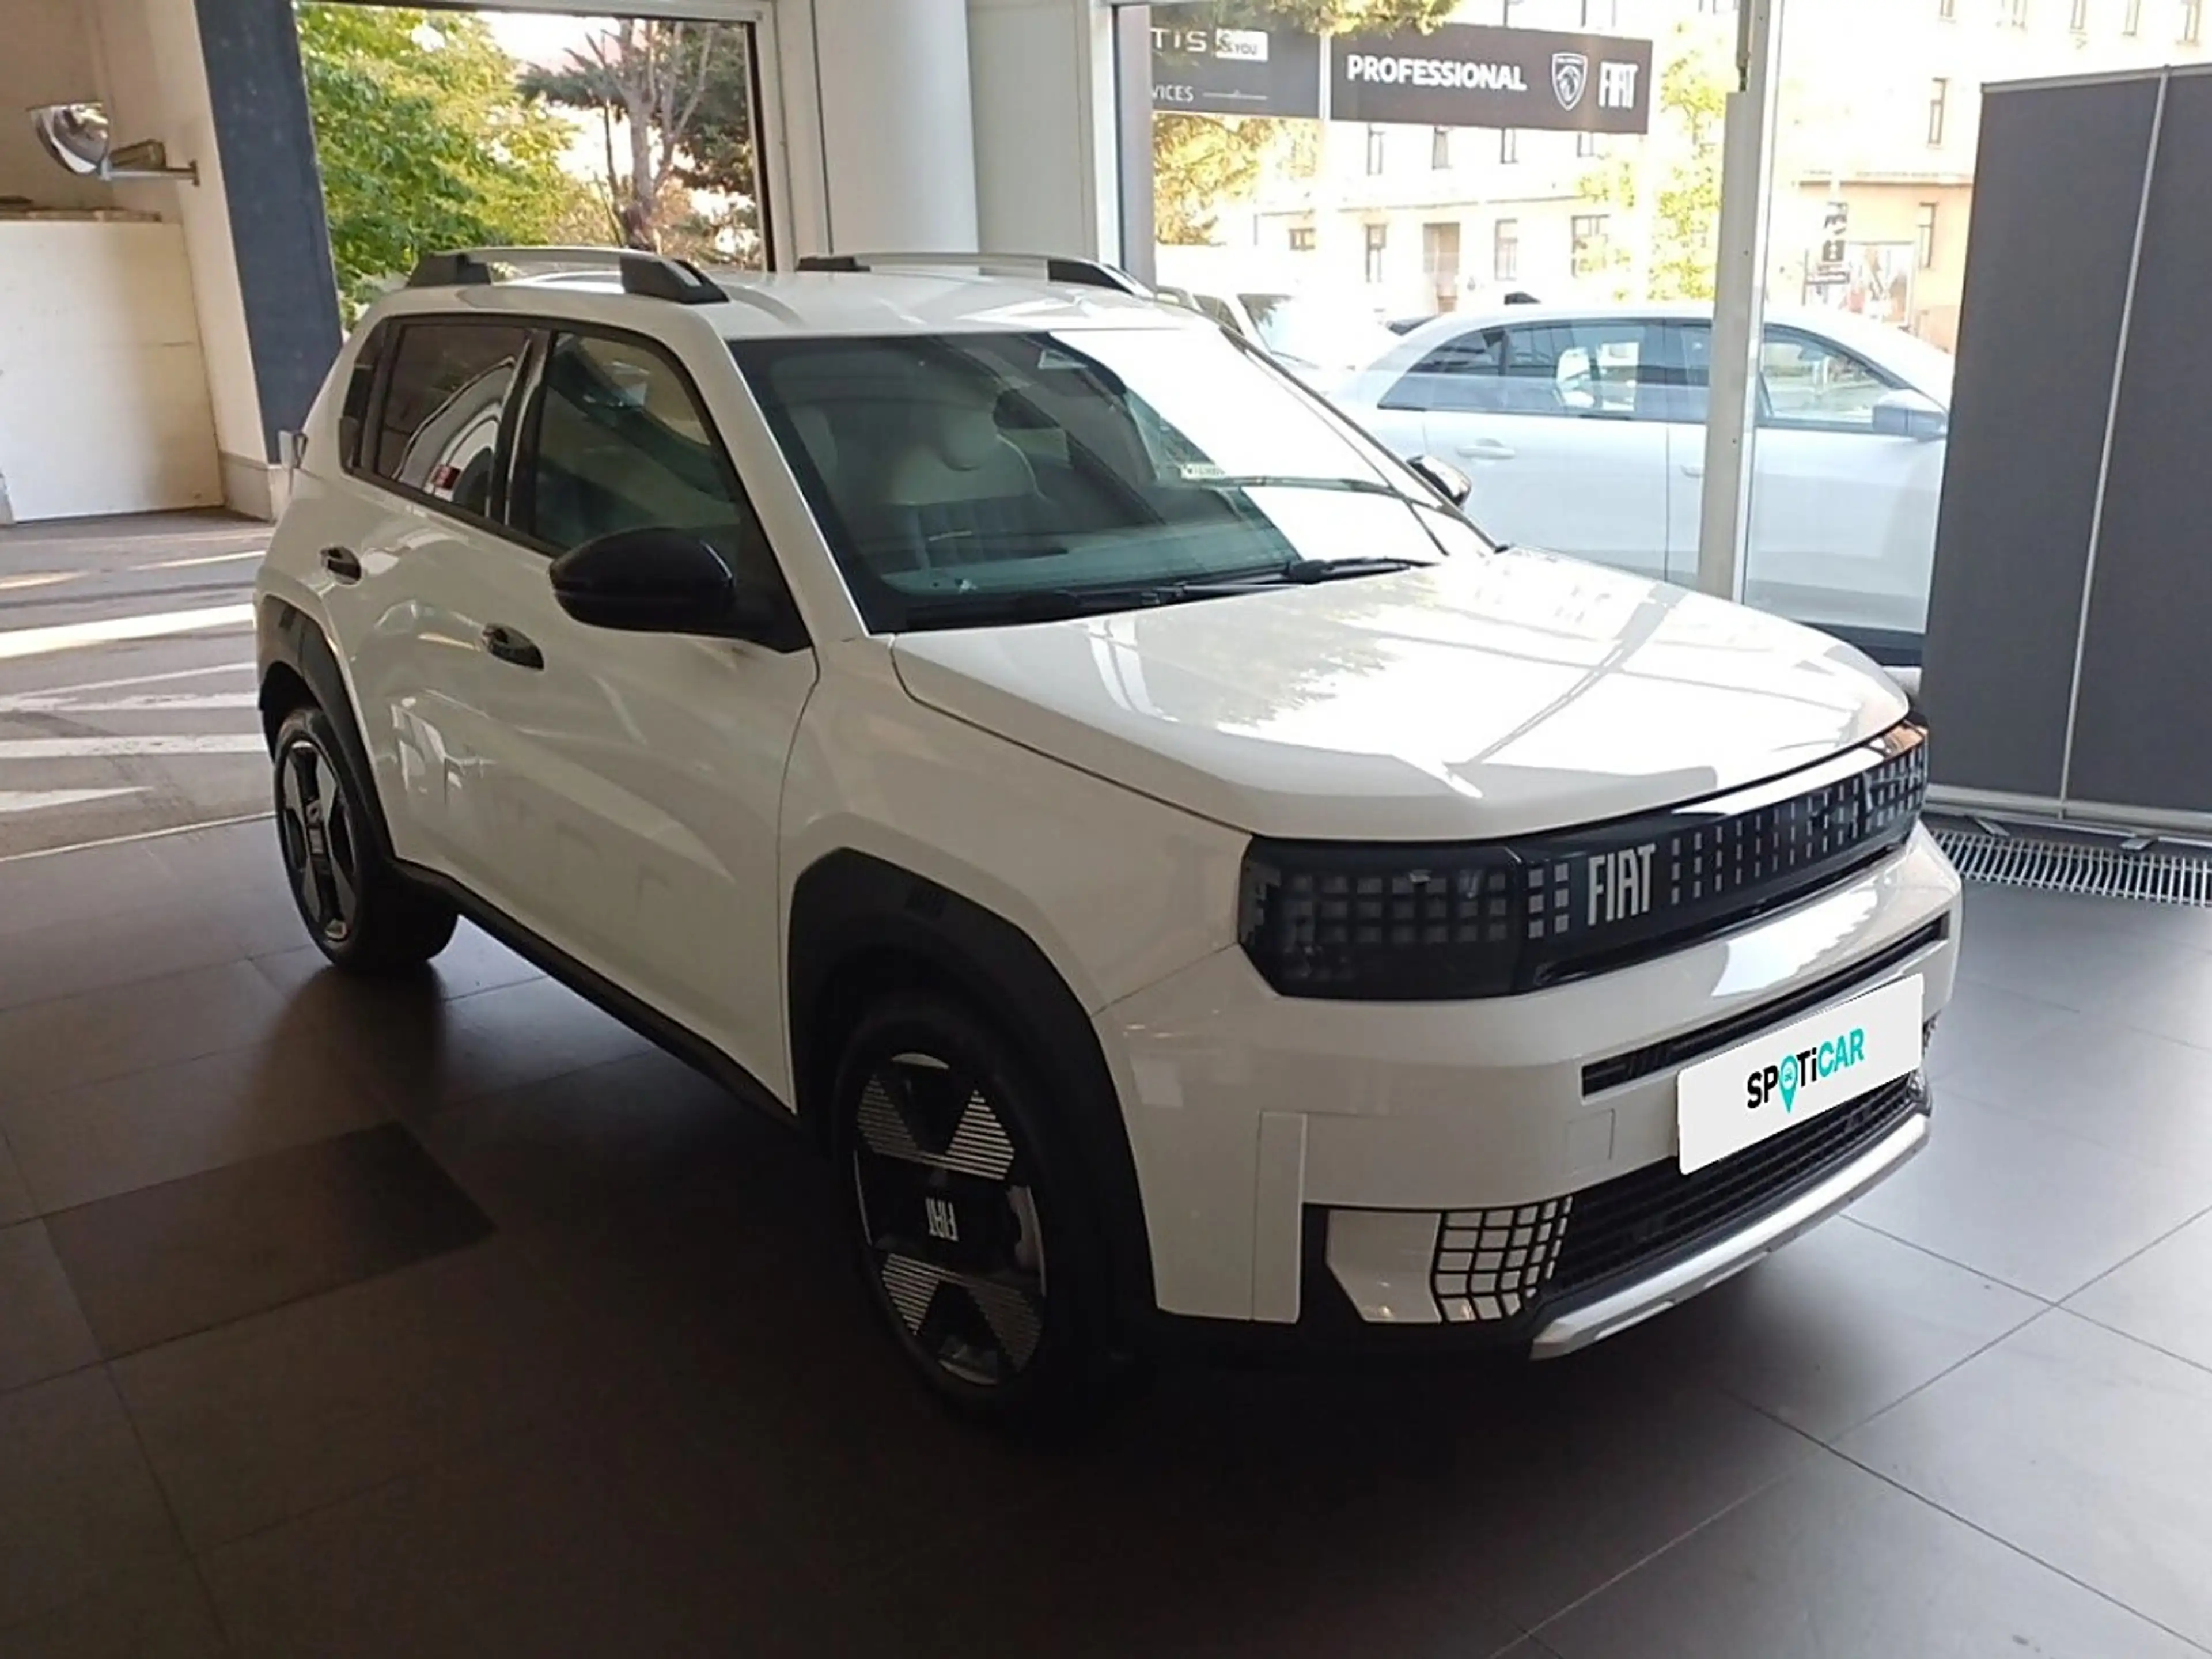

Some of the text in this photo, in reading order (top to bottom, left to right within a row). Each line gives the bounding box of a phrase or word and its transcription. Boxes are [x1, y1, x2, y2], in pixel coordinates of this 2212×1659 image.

[1347, 55, 1527, 92] PROFESSIONAL
[1598, 61, 1639, 108] FIAT
[1588, 843, 1657, 926] FIAT
